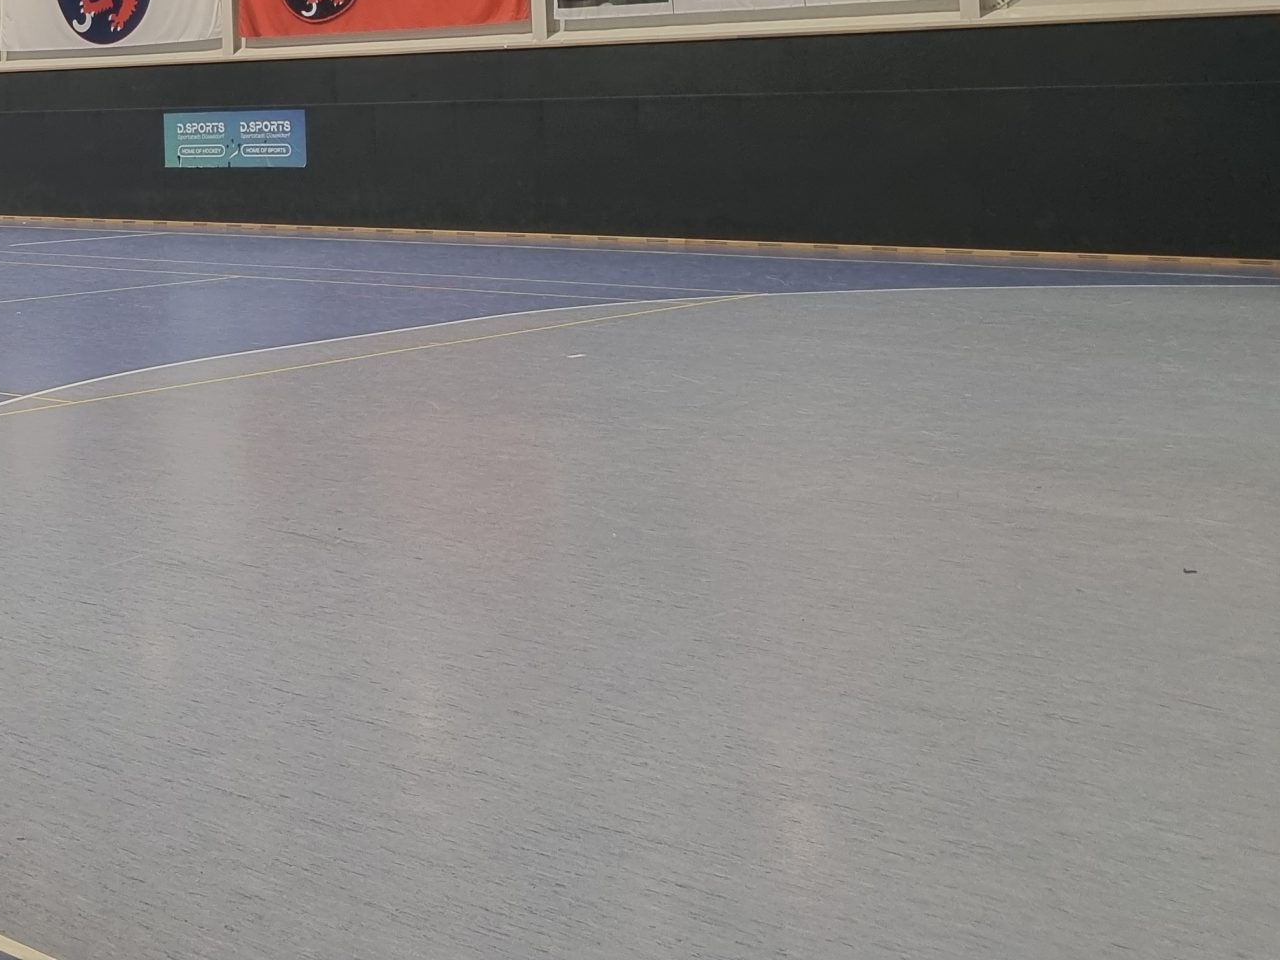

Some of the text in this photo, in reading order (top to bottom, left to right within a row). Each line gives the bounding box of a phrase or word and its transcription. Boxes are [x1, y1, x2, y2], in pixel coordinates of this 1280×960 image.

[177, 122, 225, 134] D.SPORTS
[240, 120, 291, 133] D.SPORTS
[181, 147, 195, 155] HOME
